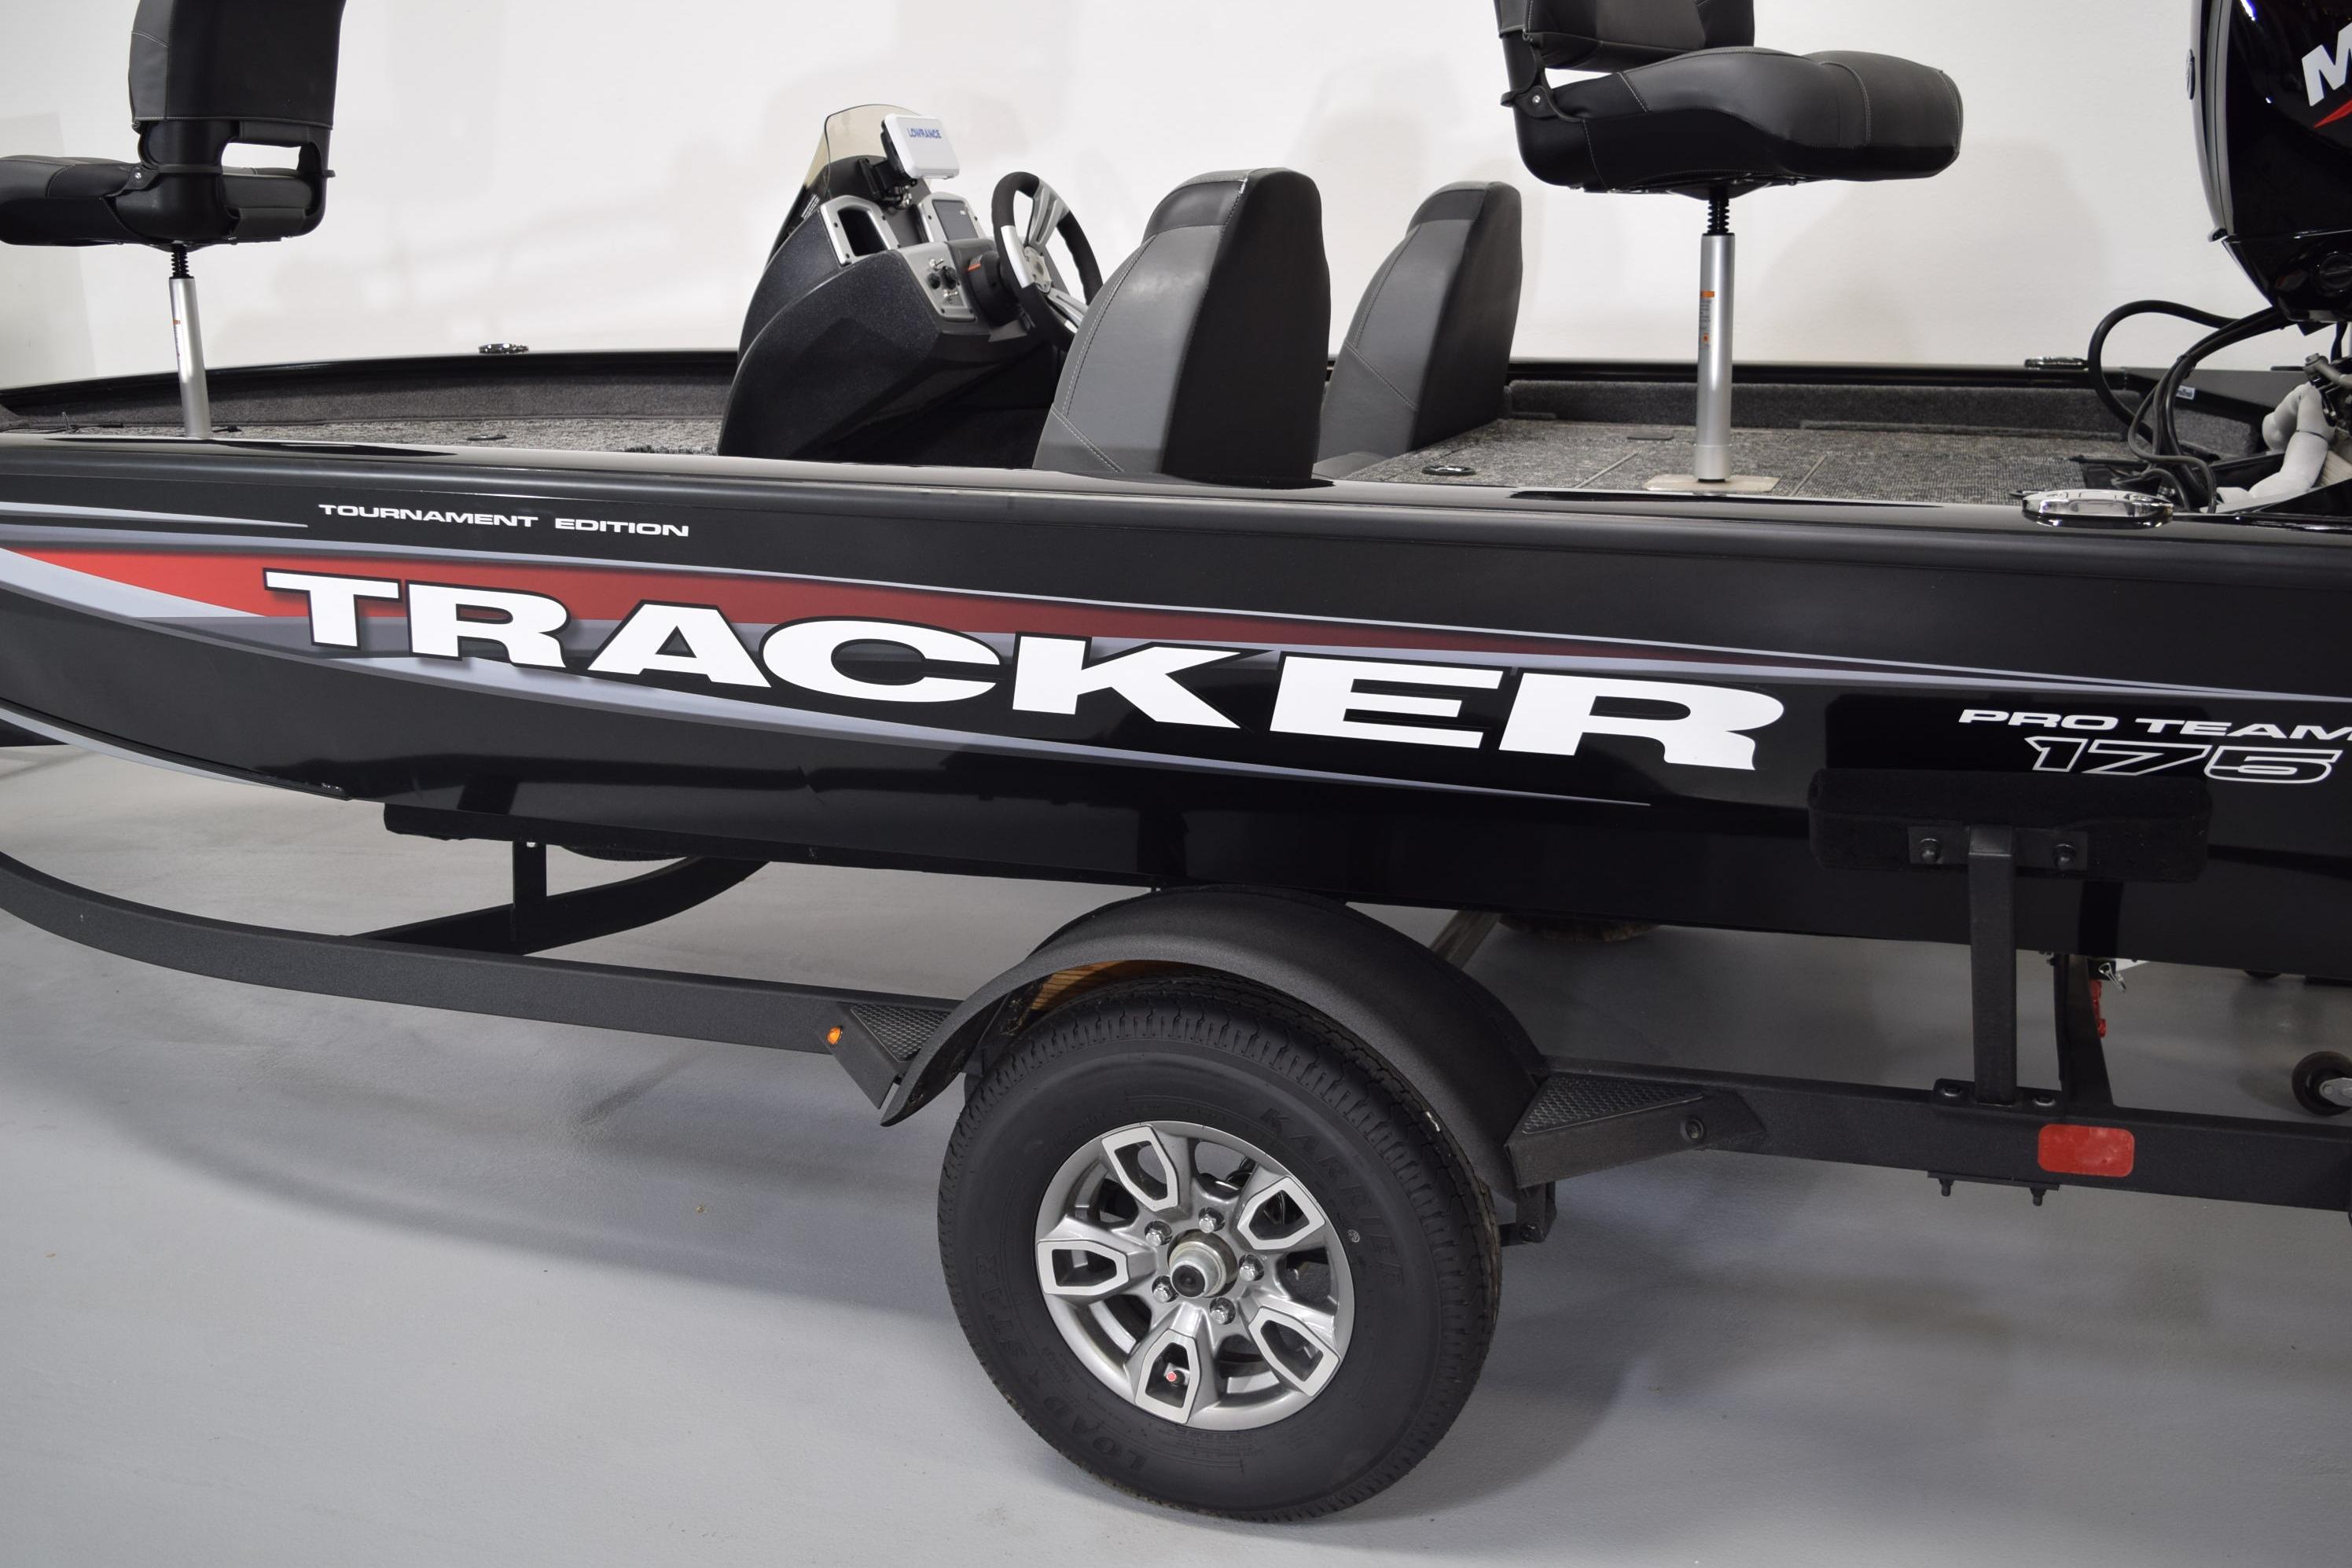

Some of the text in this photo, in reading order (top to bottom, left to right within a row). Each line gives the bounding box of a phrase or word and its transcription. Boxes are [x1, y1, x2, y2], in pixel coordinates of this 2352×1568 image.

[906, 127, 942, 139] LOWRANCE
[318, 504, 689, 537] TOURNAMENT EDITION
[263, 569, 1784, 772] TRACKER
[1958, 709, 2352, 741] PRO TEAM
[2023, 736, 2343, 784] 175
